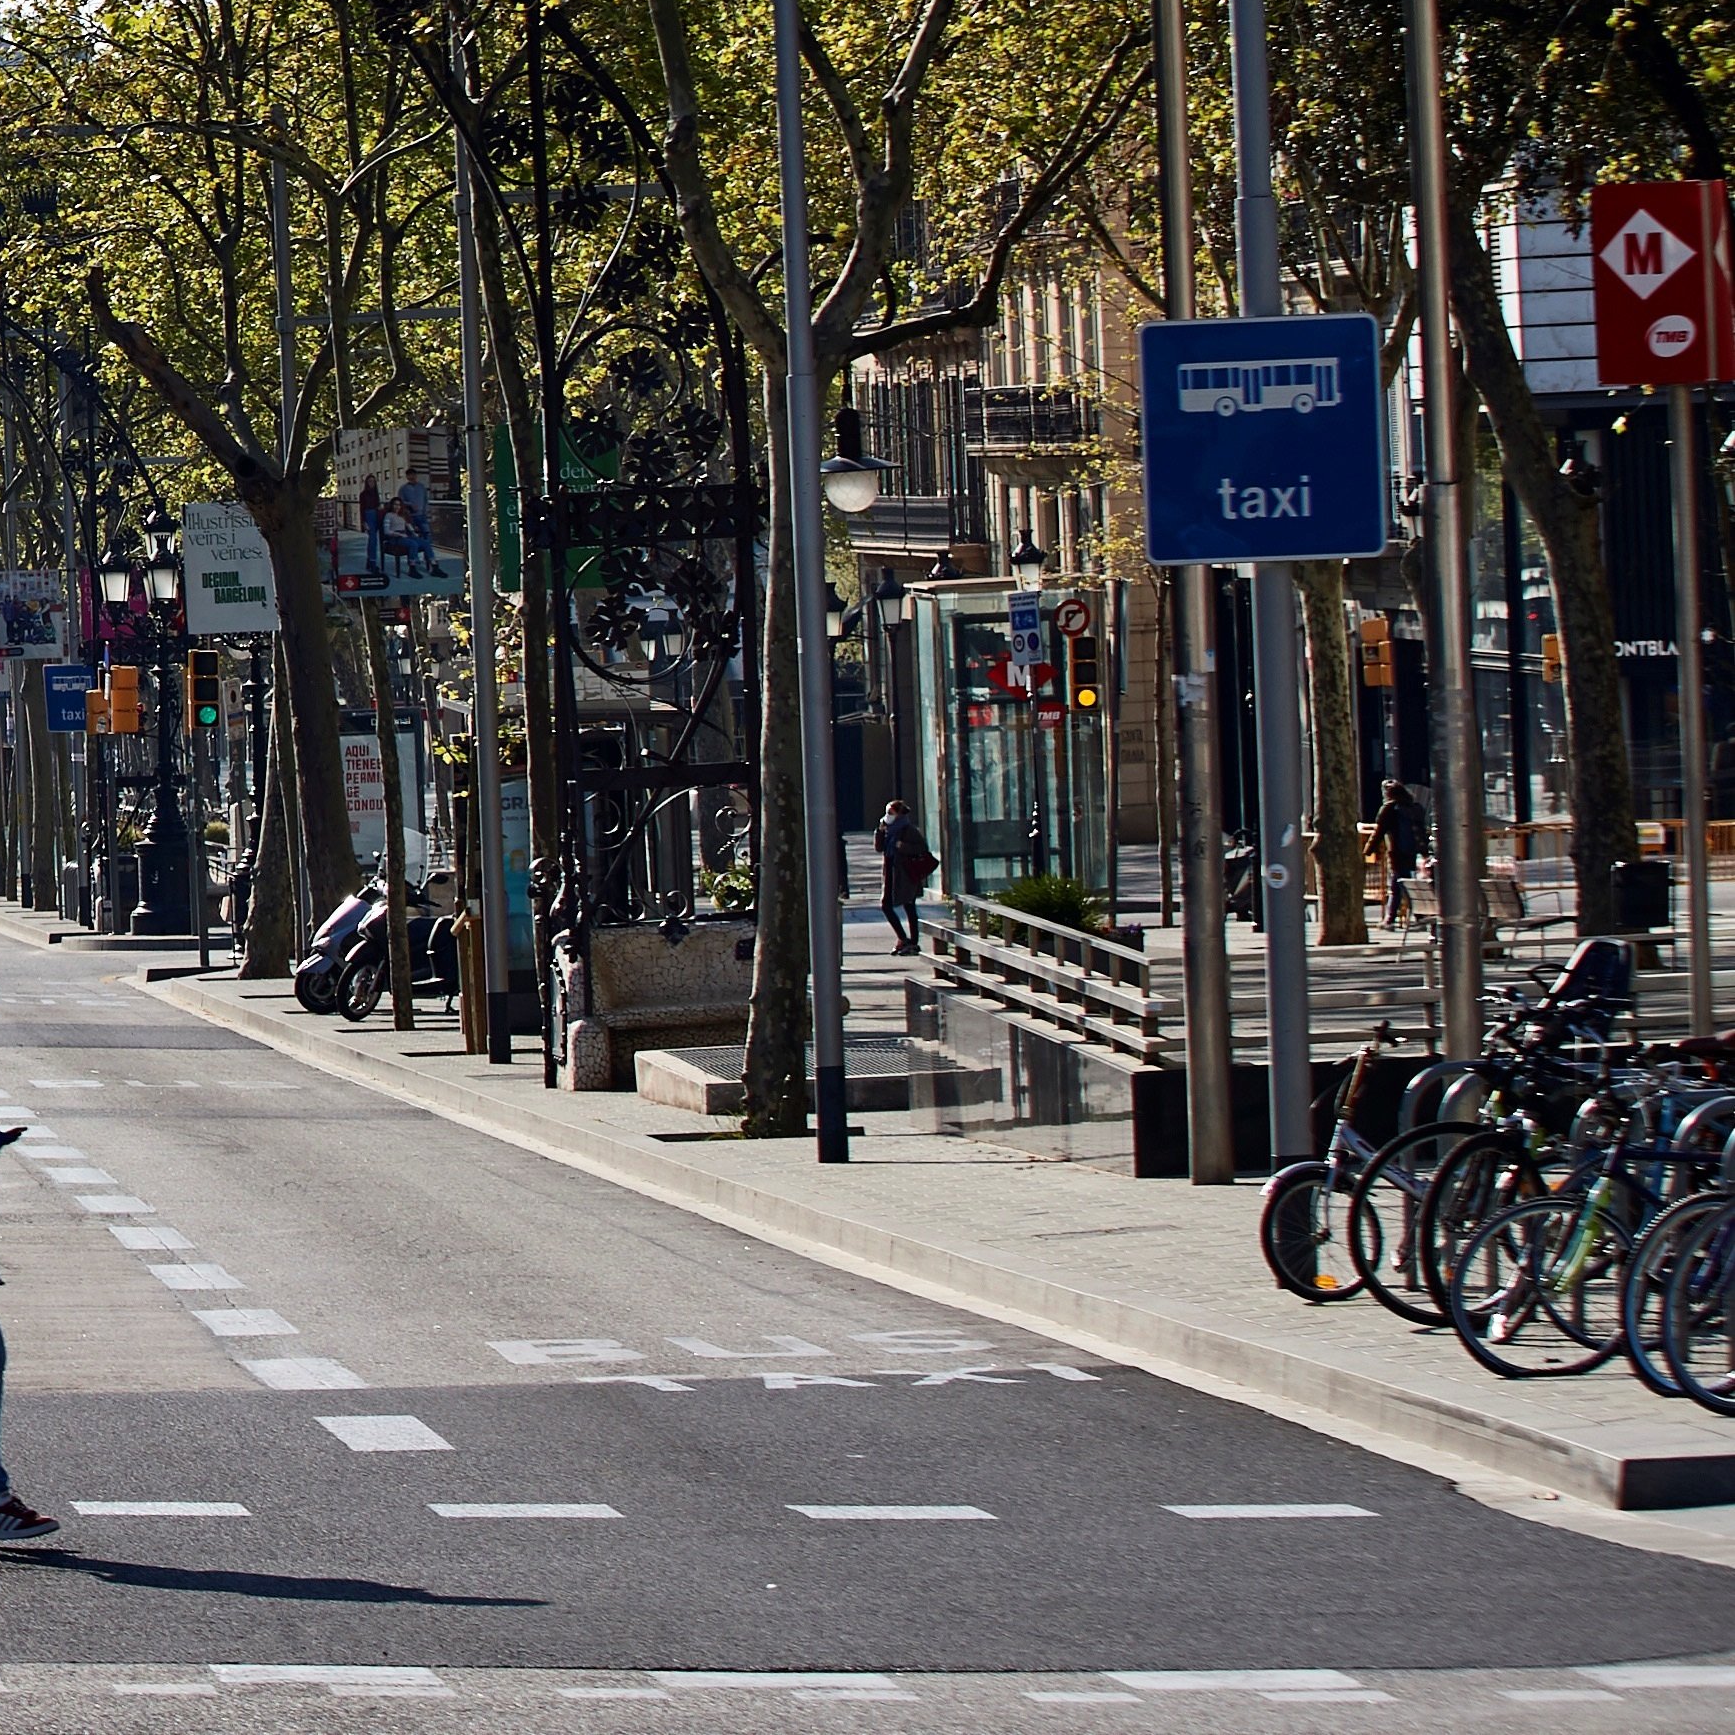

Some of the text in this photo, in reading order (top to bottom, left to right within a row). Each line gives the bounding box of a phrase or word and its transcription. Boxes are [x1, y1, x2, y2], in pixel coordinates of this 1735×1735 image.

[1624, 232, 1664, 275] M
[1656, 330, 1689, 343] TMB
[1216, 474, 1312, 520] taxi
[214, 586, 267, 604] BARCELONA
[1006, 661, 1031, 687] M
[61, 708, 86, 721] taxi
[1037, 711, 1061, 721] TMB
[485, 1328, 1000, 1366] BUS
[576, 1361, 1103, 1393] TAXI
